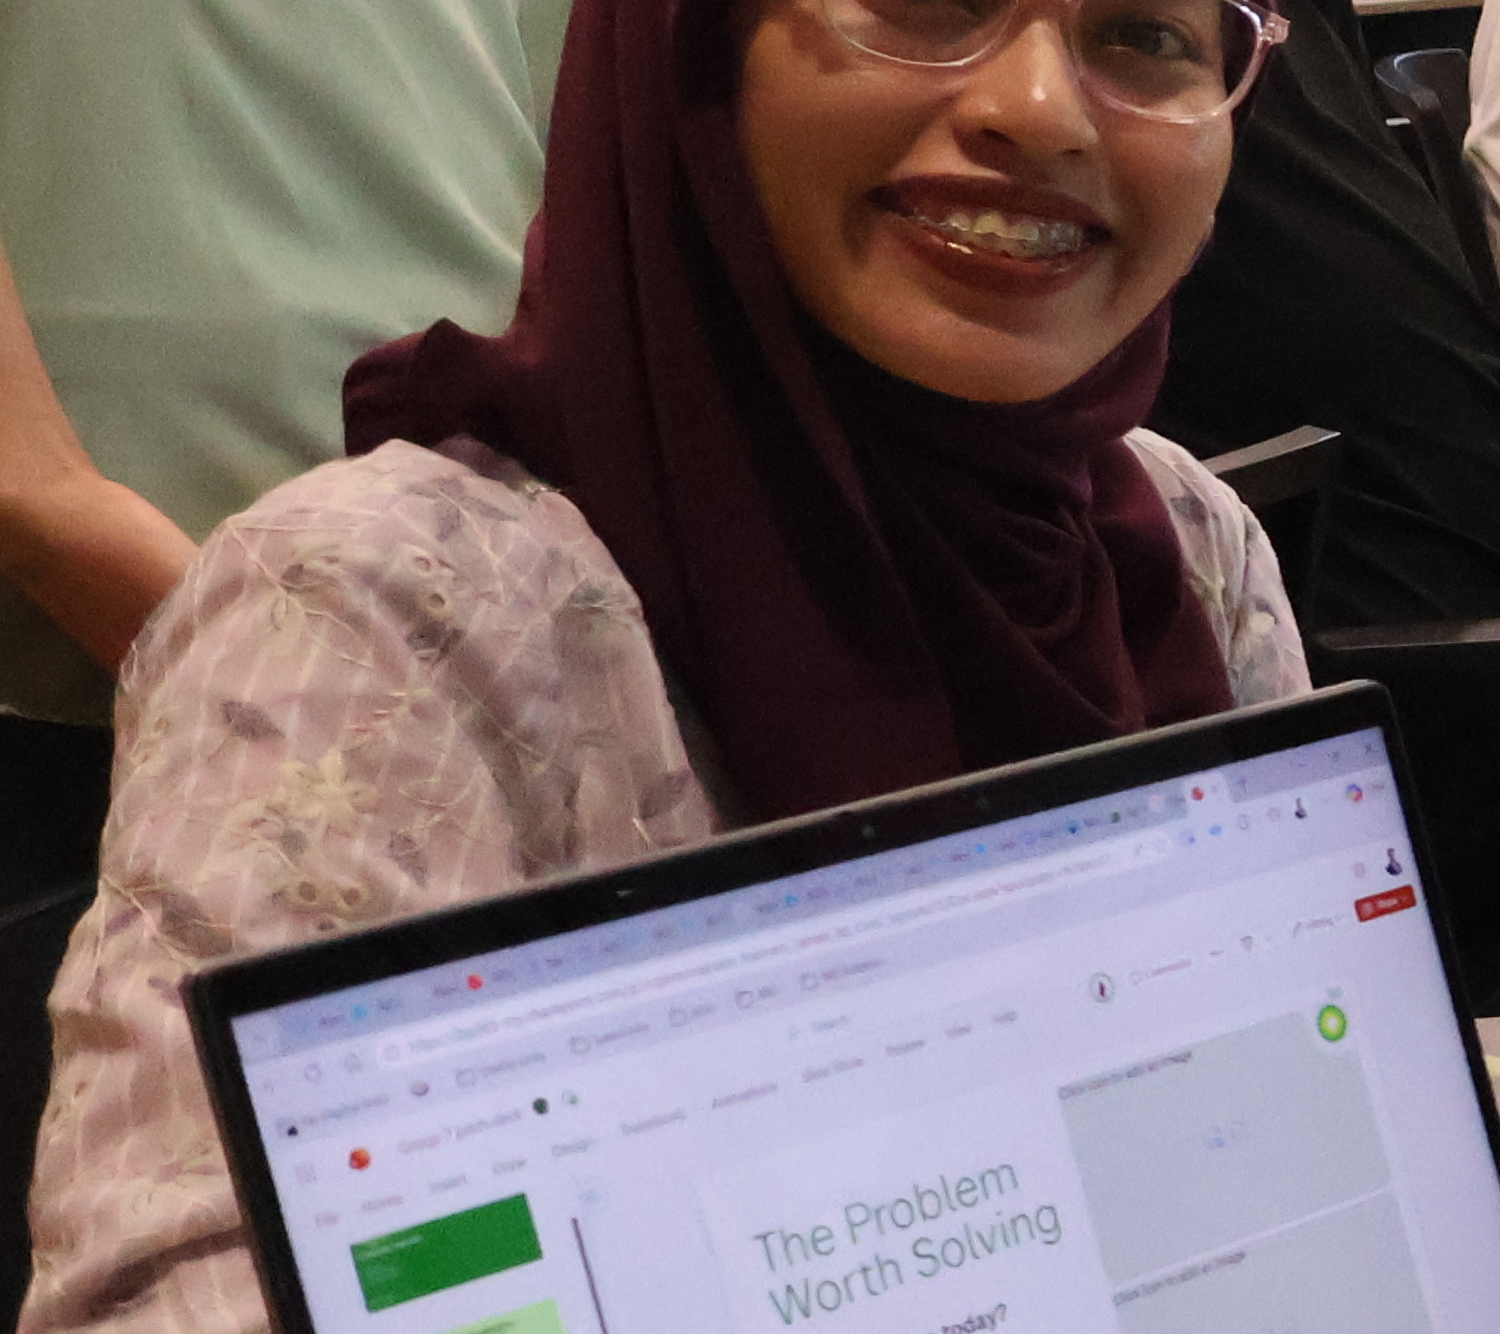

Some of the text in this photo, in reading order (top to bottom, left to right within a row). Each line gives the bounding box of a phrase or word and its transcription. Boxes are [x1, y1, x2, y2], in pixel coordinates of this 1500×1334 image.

[753, 1164, 1020, 1273] The Problem
[769, 1254, 904, 1326] Worth
[912, 1205, 1063, 1279] Solving
